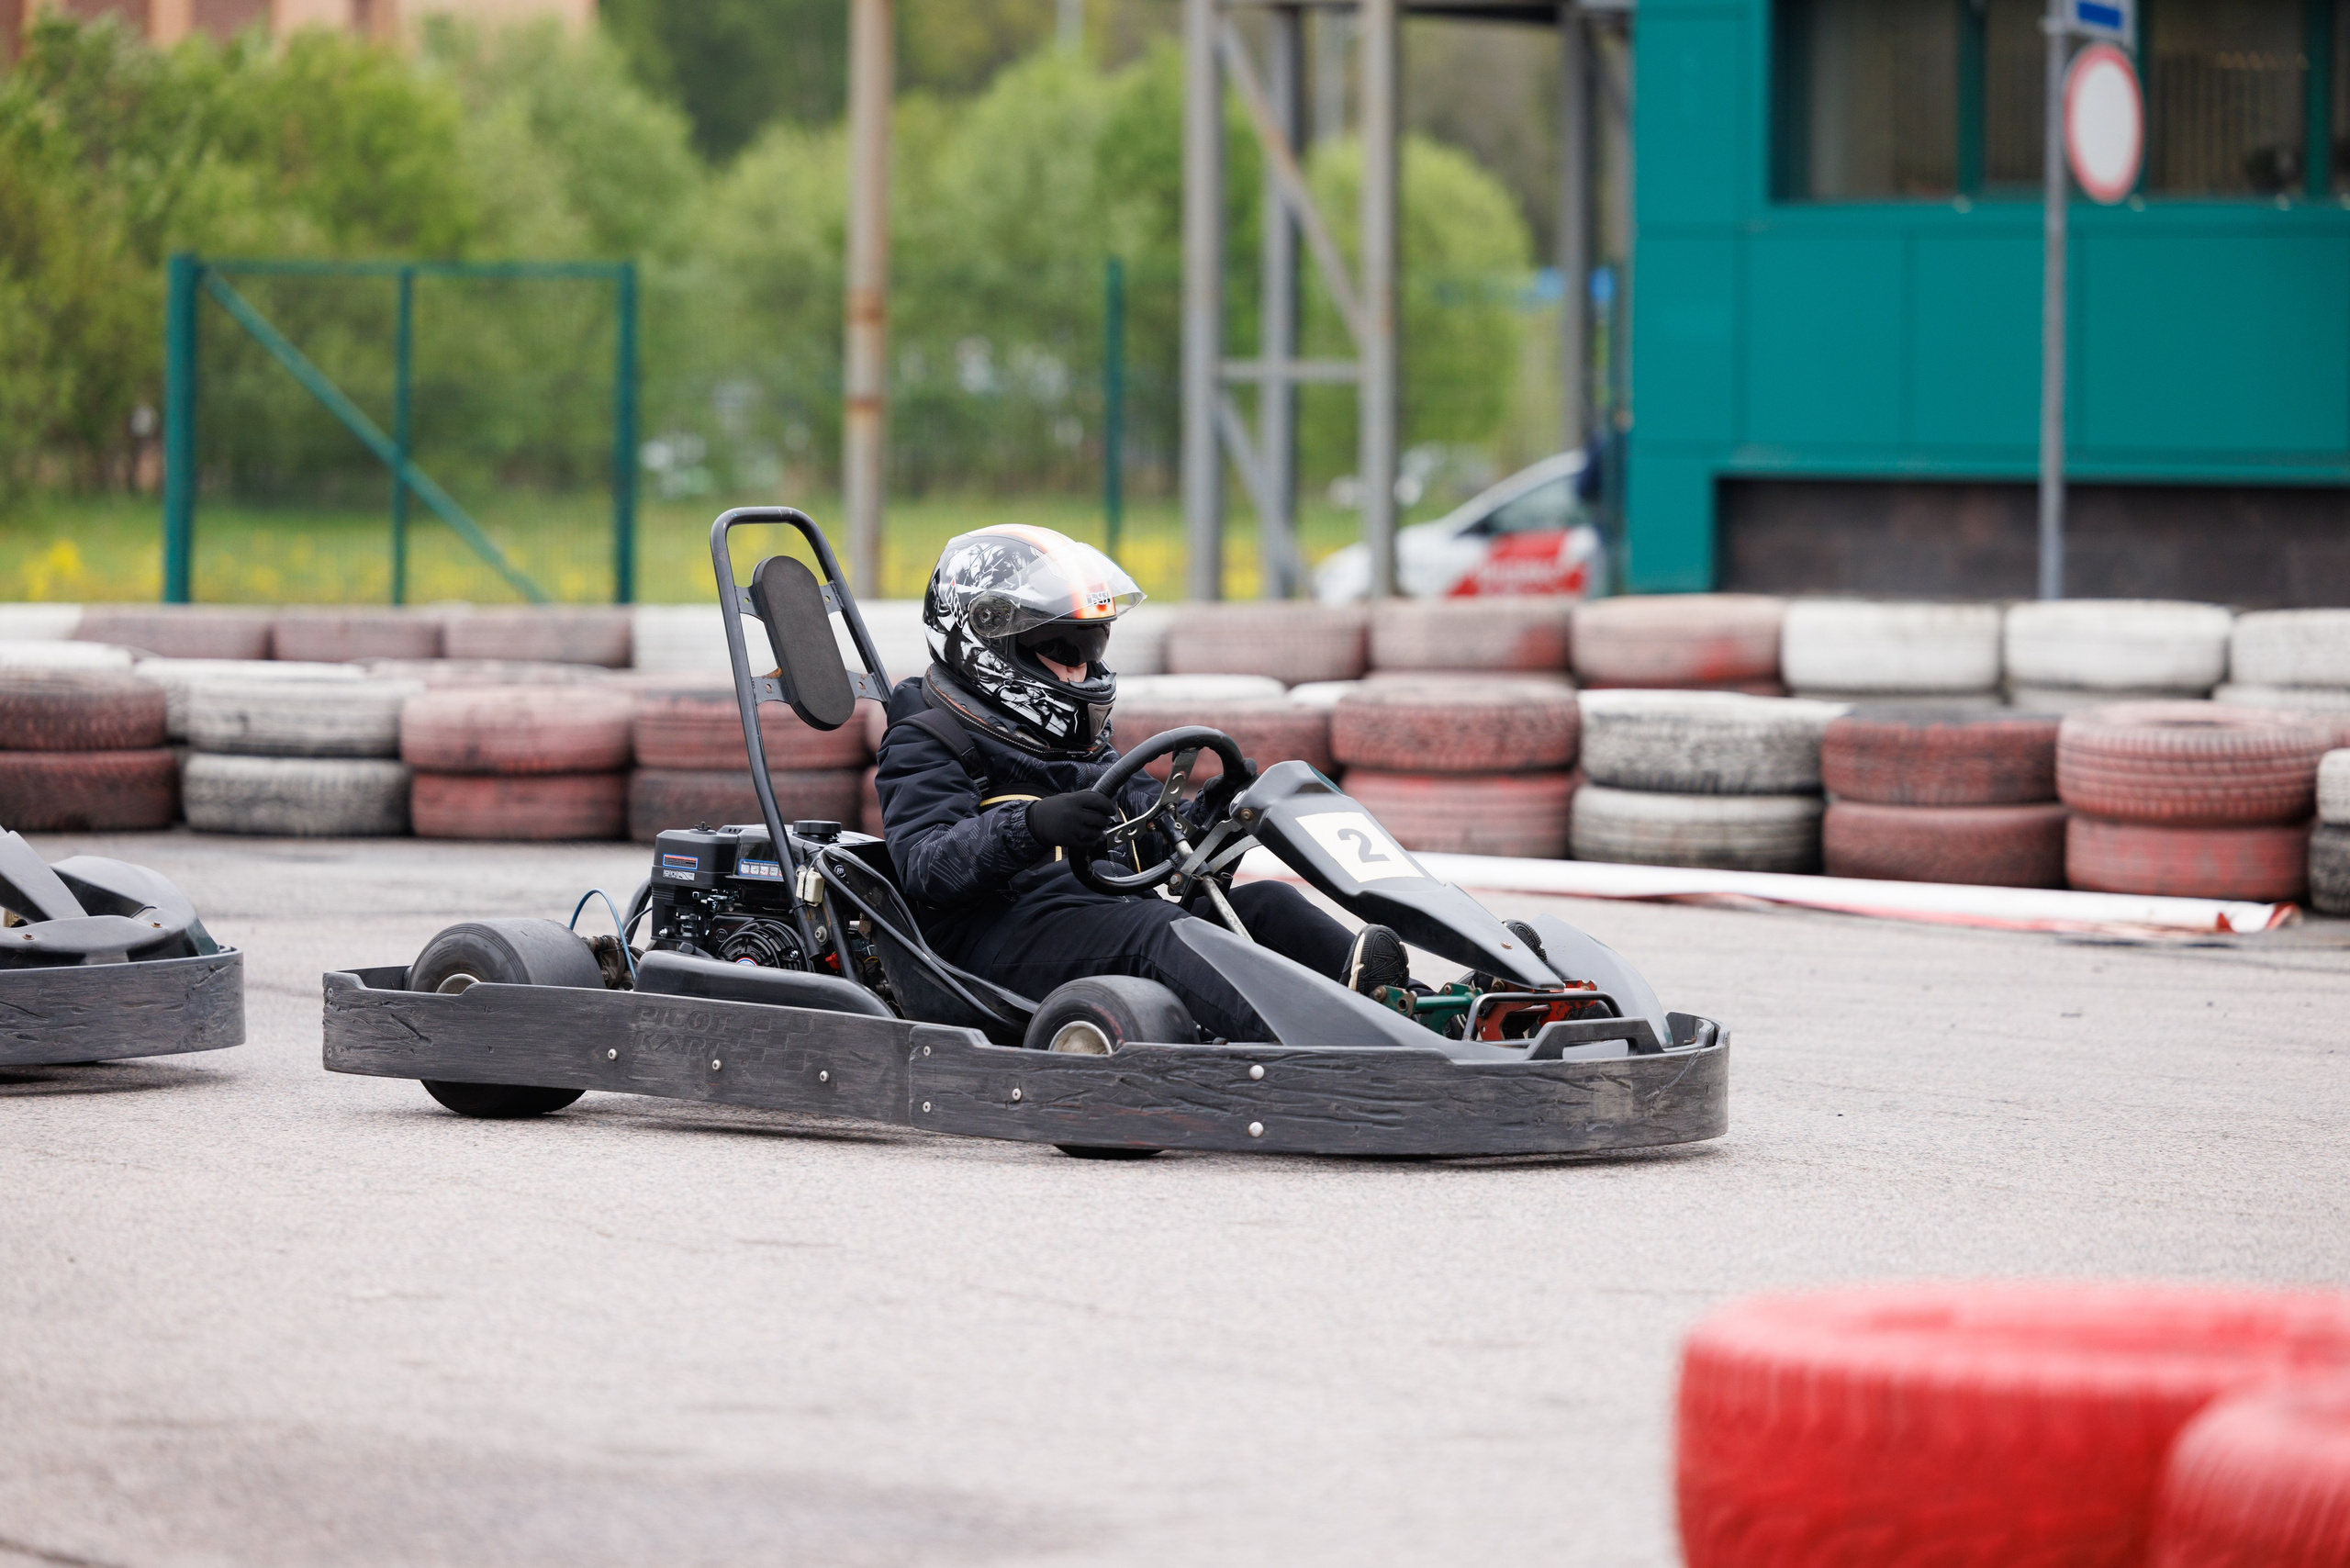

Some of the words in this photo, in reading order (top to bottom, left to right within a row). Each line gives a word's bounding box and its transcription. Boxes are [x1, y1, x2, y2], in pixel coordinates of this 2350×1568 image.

[1337, 828, 1391, 863] 2
[632, 1004, 734, 1034] PILOT
[632, 1031, 731, 1058] KART
